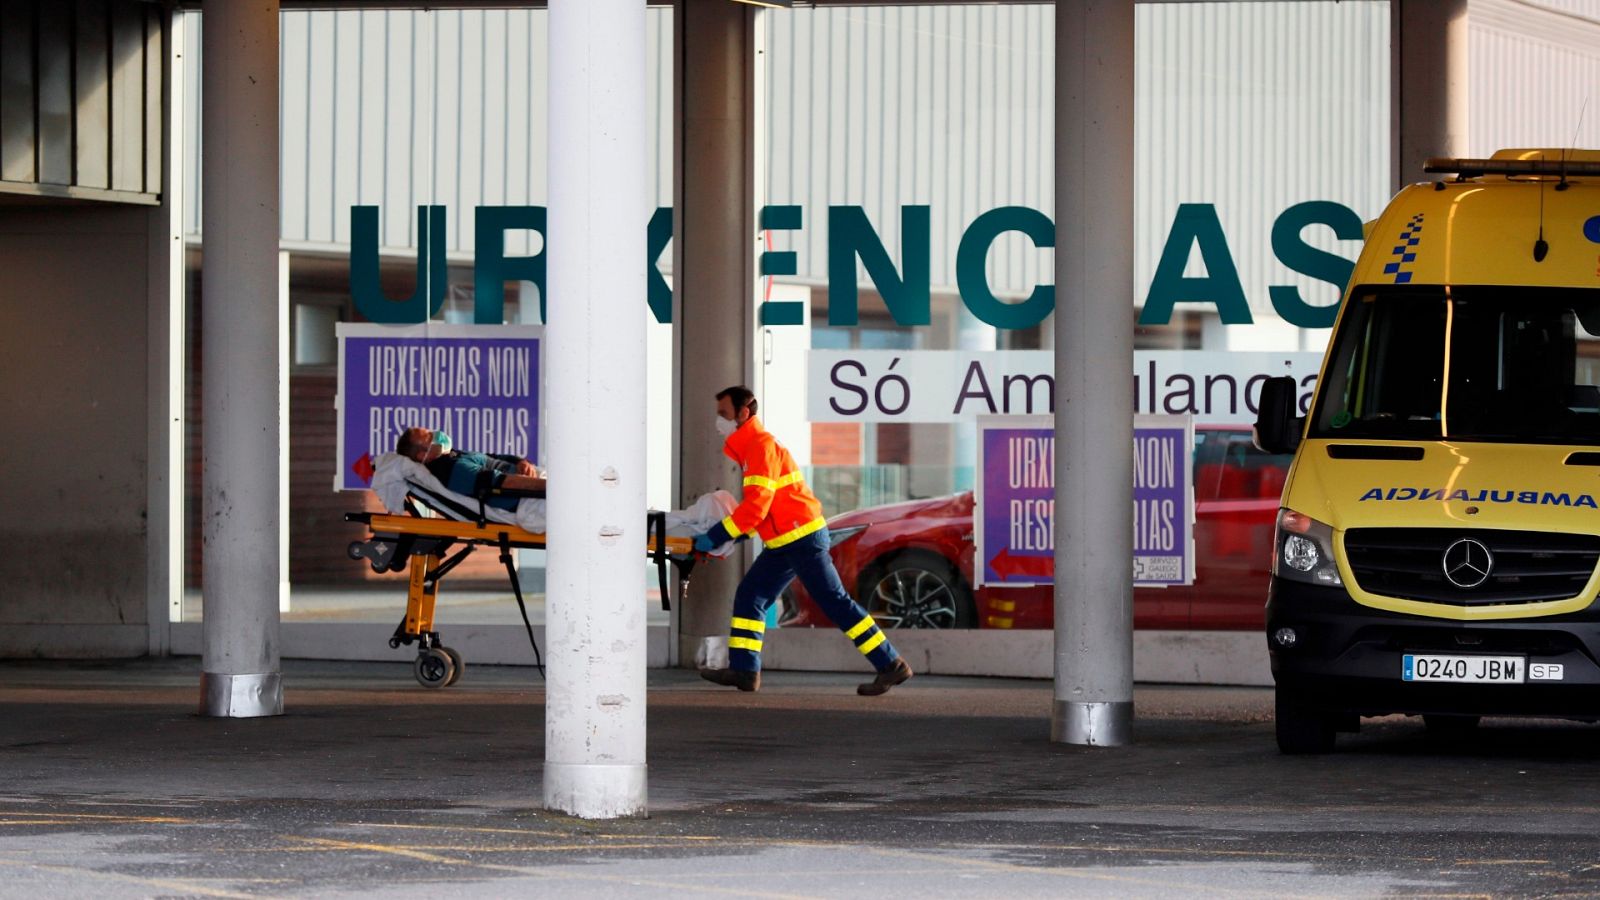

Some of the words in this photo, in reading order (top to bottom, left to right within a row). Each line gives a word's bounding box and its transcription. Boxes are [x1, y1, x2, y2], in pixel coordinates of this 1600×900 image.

[369, 346, 480, 397] URXENCIAS
[488, 347, 529, 397] NON
[829, 358, 911, 416] Só
[1134, 437, 1174, 488] NON
[1417, 658, 1467, 678] 0240
[1475, 660, 1515, 680] JBM
[1533, 665, 1560, 678] SP
